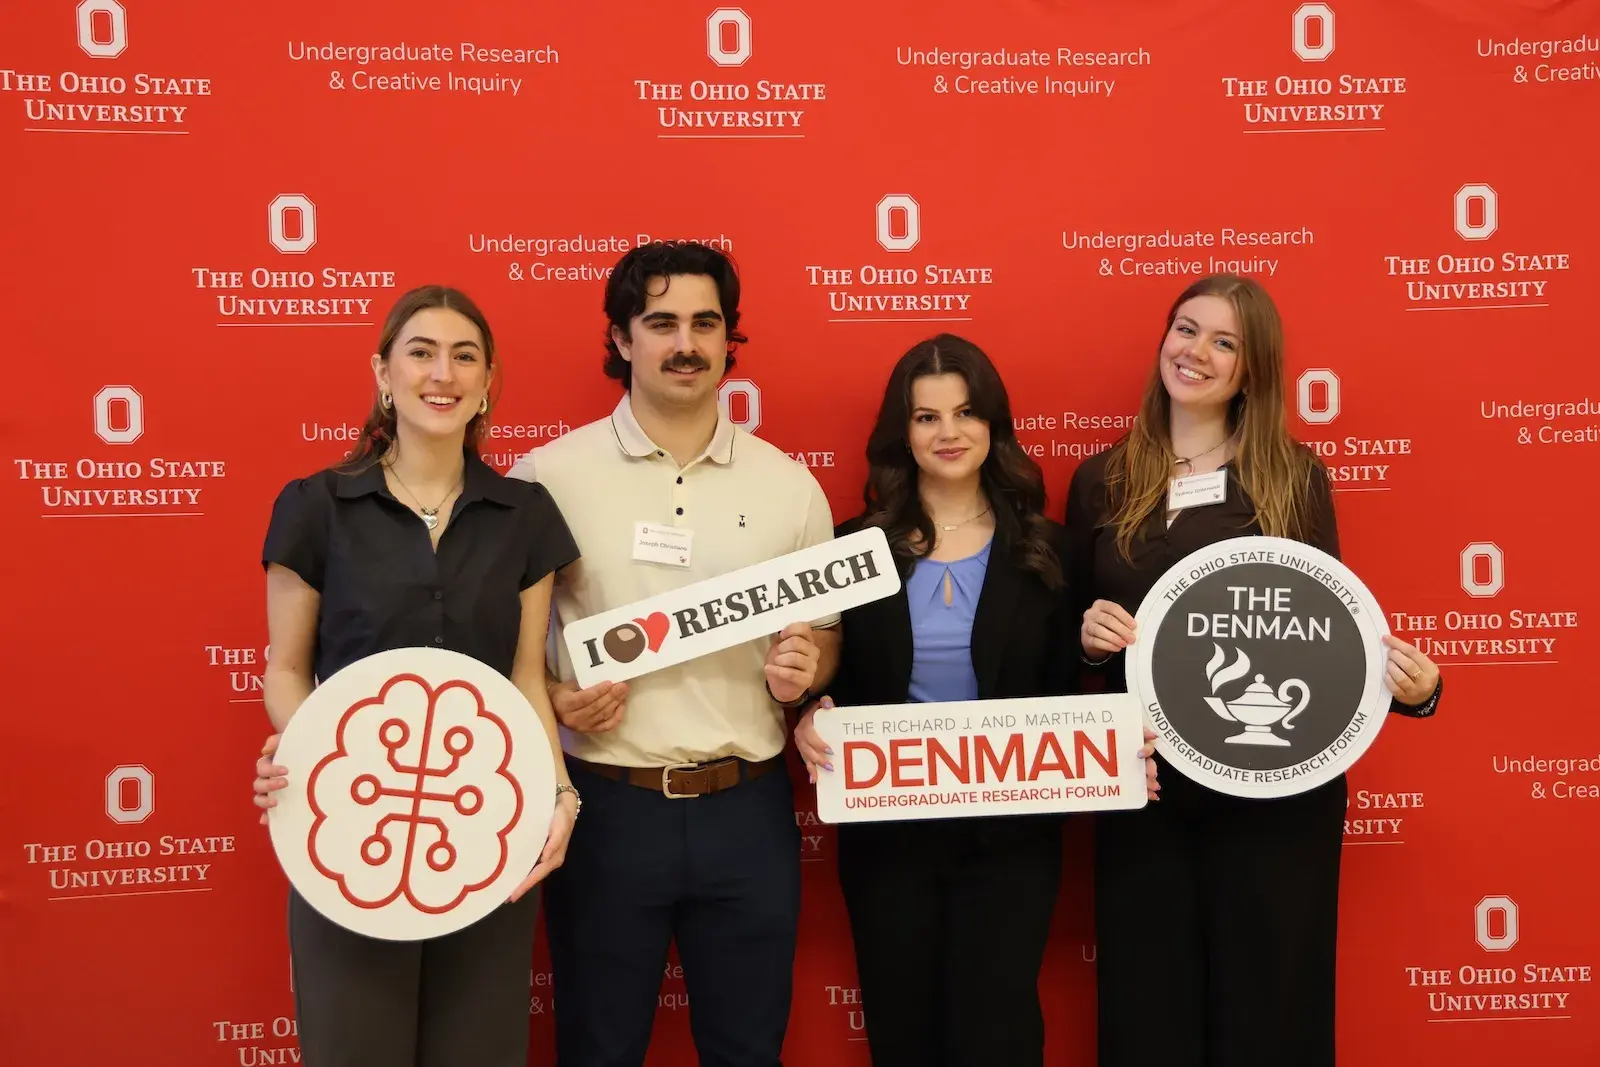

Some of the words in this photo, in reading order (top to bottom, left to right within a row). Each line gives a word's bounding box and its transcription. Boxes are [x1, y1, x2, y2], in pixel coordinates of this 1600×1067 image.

[288, 41, 454, 65] Undergraduate
[460, 42, 559, 64] Research
[896, 46, 1051, 70] Undergraduate
[1057, 47, 1151, 66] Research
[1477, 34, 1600, 59] Undergradu
[0, 69, 52, 92] THE
[59, 71, 127, 94] OHIO
[134, 73, 212, 96] STATE
[328, 70, 346, 90] &
[351, 70, 441, 91] Creative
[448, 71, 523, 96] Inquiry
[933, 74, 949, 94] &
[954, 75, 1039, 94] Creative
[1045, 75, 1116, 98] Inquiry
[1221, 77, 1268, 97] THE
[1275, 75, 1332, 96] OHIO
[1339, 74, 1406, 95] STATE
[1513, 65, 1529, 84] &
[633, 79, 683, 101] THE
[690, 80, 750, 101] OHIO
[756, 79, 826, 101] STATE
[23, 98, 188, 123] UNIVERSITY
[657, 106, 804, 128] UNIVERSITY
[1243, 102, 1385, 123] UNIVERSITY
[469, 233, 630, 257] Undergraduate
[1062, 229, 1215, 253] Undergraduate
[1221, 226, 1314, 246] Research
[508, 262, 525, 281] &
[805, 265, 853, 286] THE
[859, 265, 918, 285] OHIO
[924, 264, 993, 285] STATE
[1098, 257, 1114, 277] &
[1119, 256, 1203, 276] Creative
[1209, 255, 1279, 277] Inquiry
[1384, 255, 1431, 276] THE
[1437, 254, 1495, 274] OHIO
[1501, 251, 1570, 272] STATE
[191, 267, 244, 289] THE
[251, 267, 315, 289] OHIO
[322, 267, 396, 288] STATE
[828, 291, 972, 312] UNIVERSITY
[1405, 280, 1548, 301] UNIVERSITY
[216, 295, 373, 316] UNIVERSITY
[1480, 397, 1600, 421] Undergradu
[489, 419, 571, 439] esearch
[1517, 426, 1533, 445] &
[1538, 424, 1600, 444] Creati
[1344, 436, 1412, 456] STATE
[14, 459, 69, 480] THE
[76, 458, 142, 479] OHIO
[149, 457, 226, 479] STATE
[784, 452, 835, 468] ATE
[1326, 464, 1390, 482] RSITY
[40, 486, 202, 507] UNIVERSITY
[1163, 577, 1191, 603] THE
[1190, 557, 1226, 580] OHIO
[1229, 551, 1275, 565] STATE
[582, 638, 604, 667] I
[672, 550, 881, 640] RESEARCH
[1227, 586, 1292, 613] THE
[1186, 613, 1332, 642] DENMAN
[1391, 612, 1437, 632] THE
[1444, 610, 1503, 631] OHIO
[1509, 609, 1578, 629] STATE
[204, 645, 256, 666] THE
[842, 722, 874, 736] THE
[882, 718, 956, 734] RICHARD
[981, 714, 1017, 729] AND
[1025, 711, 1095, 727] MARTHA
[1148, 702, 1250, 782] UNDERGRADUATE
[1254, 753, 1330, 783] RESEARCH
[1330, 711, 1368, 757] FORUM
[842, 728, 1119, 790] DENMAN
[1492, 753, 1600, 776] Undergrad
[845, 790, 979, 810] UNDERGRADUATE
[982, 786, 1062, 803] RESEARCH
[1065, 784, 1121, 799] FORUM
[1356, 789, 1424, 810] STATE
[1531, 781, 1547, 799] &
[1552, 780, 1600, 799] Crea
[1343, 818, 1403, 835] RSITY
[23, 843, 77, 864] THE
[85, 839, 151, 860] OHIO
[159, 835, 235, 856] STATE
[48, 863, 211, 890] UNIVERSITY
[1405, 966, 1452, 987] THE
[1458, 965, 1517, 985] OHIO
[1523, 963, 1592, 984] STATE
[824, 985, 864, 1006] TH
[1427, 992, 1570, 1012] UNIVERSITY
[212, 1020, 265, 1042] THE
